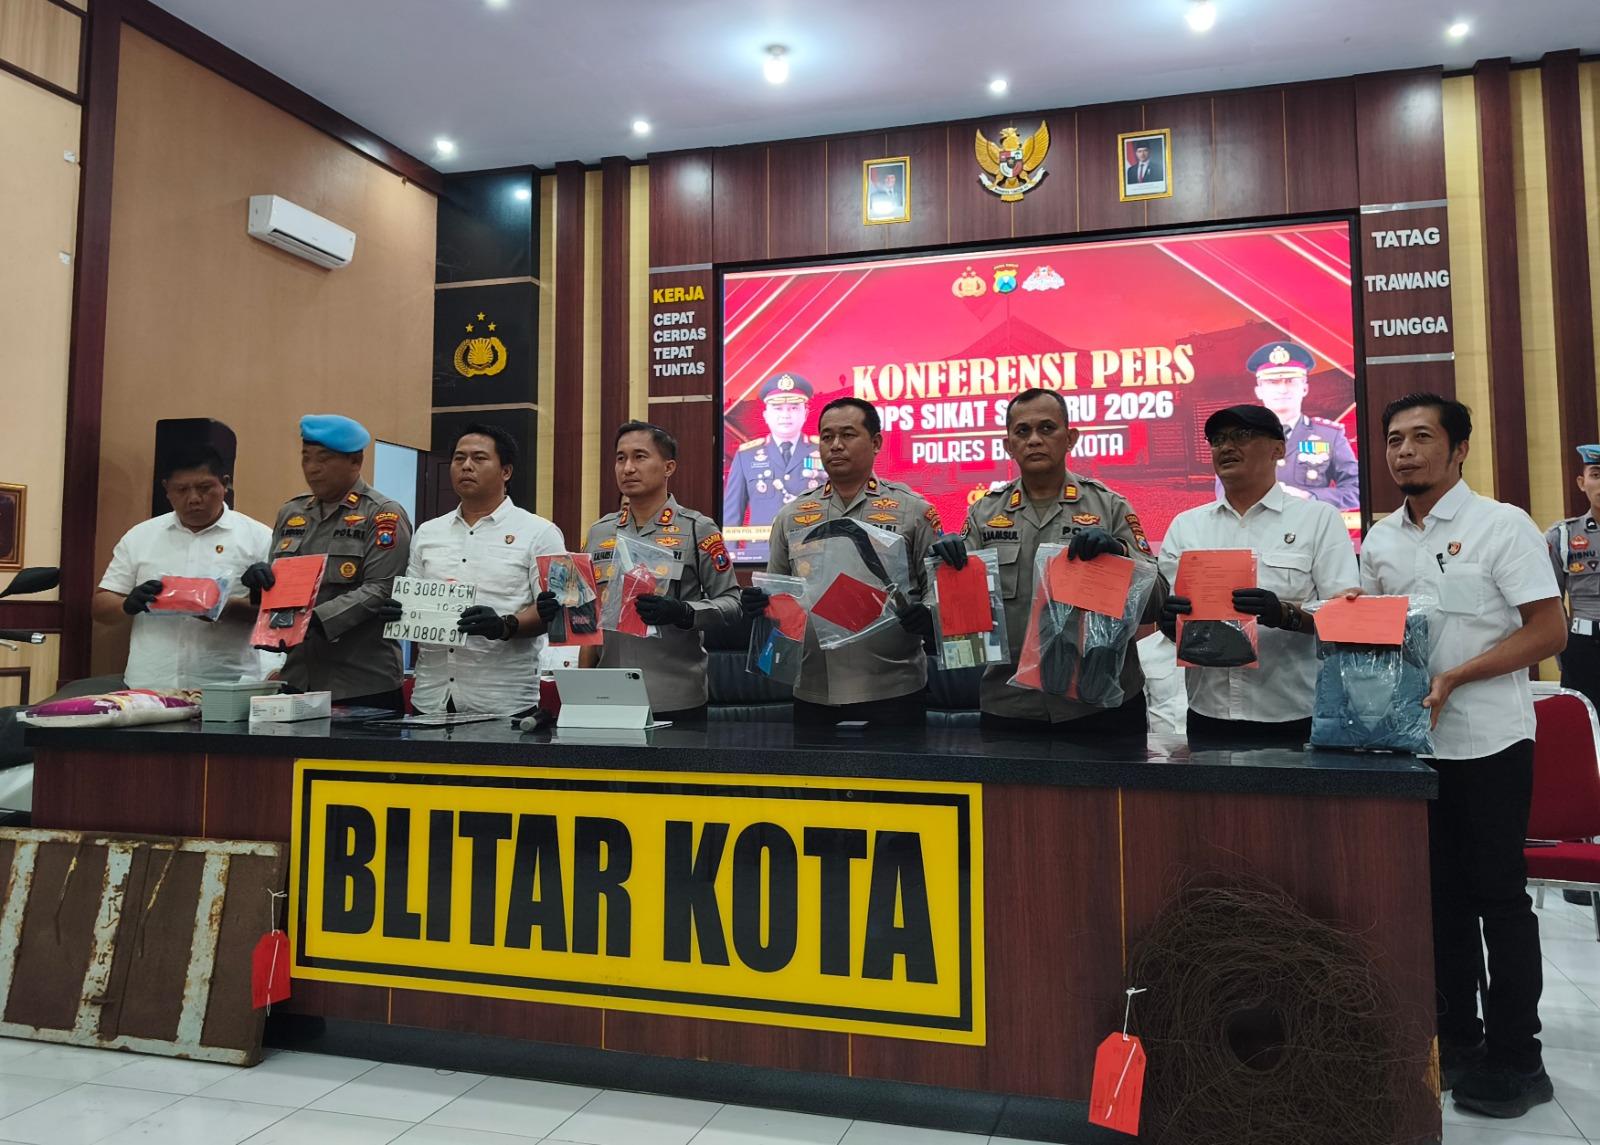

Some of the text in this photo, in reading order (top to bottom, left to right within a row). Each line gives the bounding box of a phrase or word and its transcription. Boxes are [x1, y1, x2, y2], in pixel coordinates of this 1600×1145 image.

[1371, 227, 1440, 248] TATAG
[1364, 270, 1449, 292] TRAWANG
[653, 285, 705, 303] KERJA
[653, 311, 695, 326] CEPAT
[1370, 316, 1448, 337] TUNGGA
[653, 328, 706, 343] CERDAS
[653, 346, 694, 360] TEPAT
[653, 362, 705, 377] TUNTAS
[852, 344, 1195, 401] KONFERENSI PERS
[921, 401, 988, 429] SIKAT
[1104, 390, 1173, 421] 2026
[912, 439, 985, 464] POLRES
[333, 528, 365, 539] POLRI
[394, 581, 411, 595] AG
[414, 582, 446, 597] 3080
[385, 622, 410, 639] KCW
[321, 803, 939, 985] BLITAR KOTA
